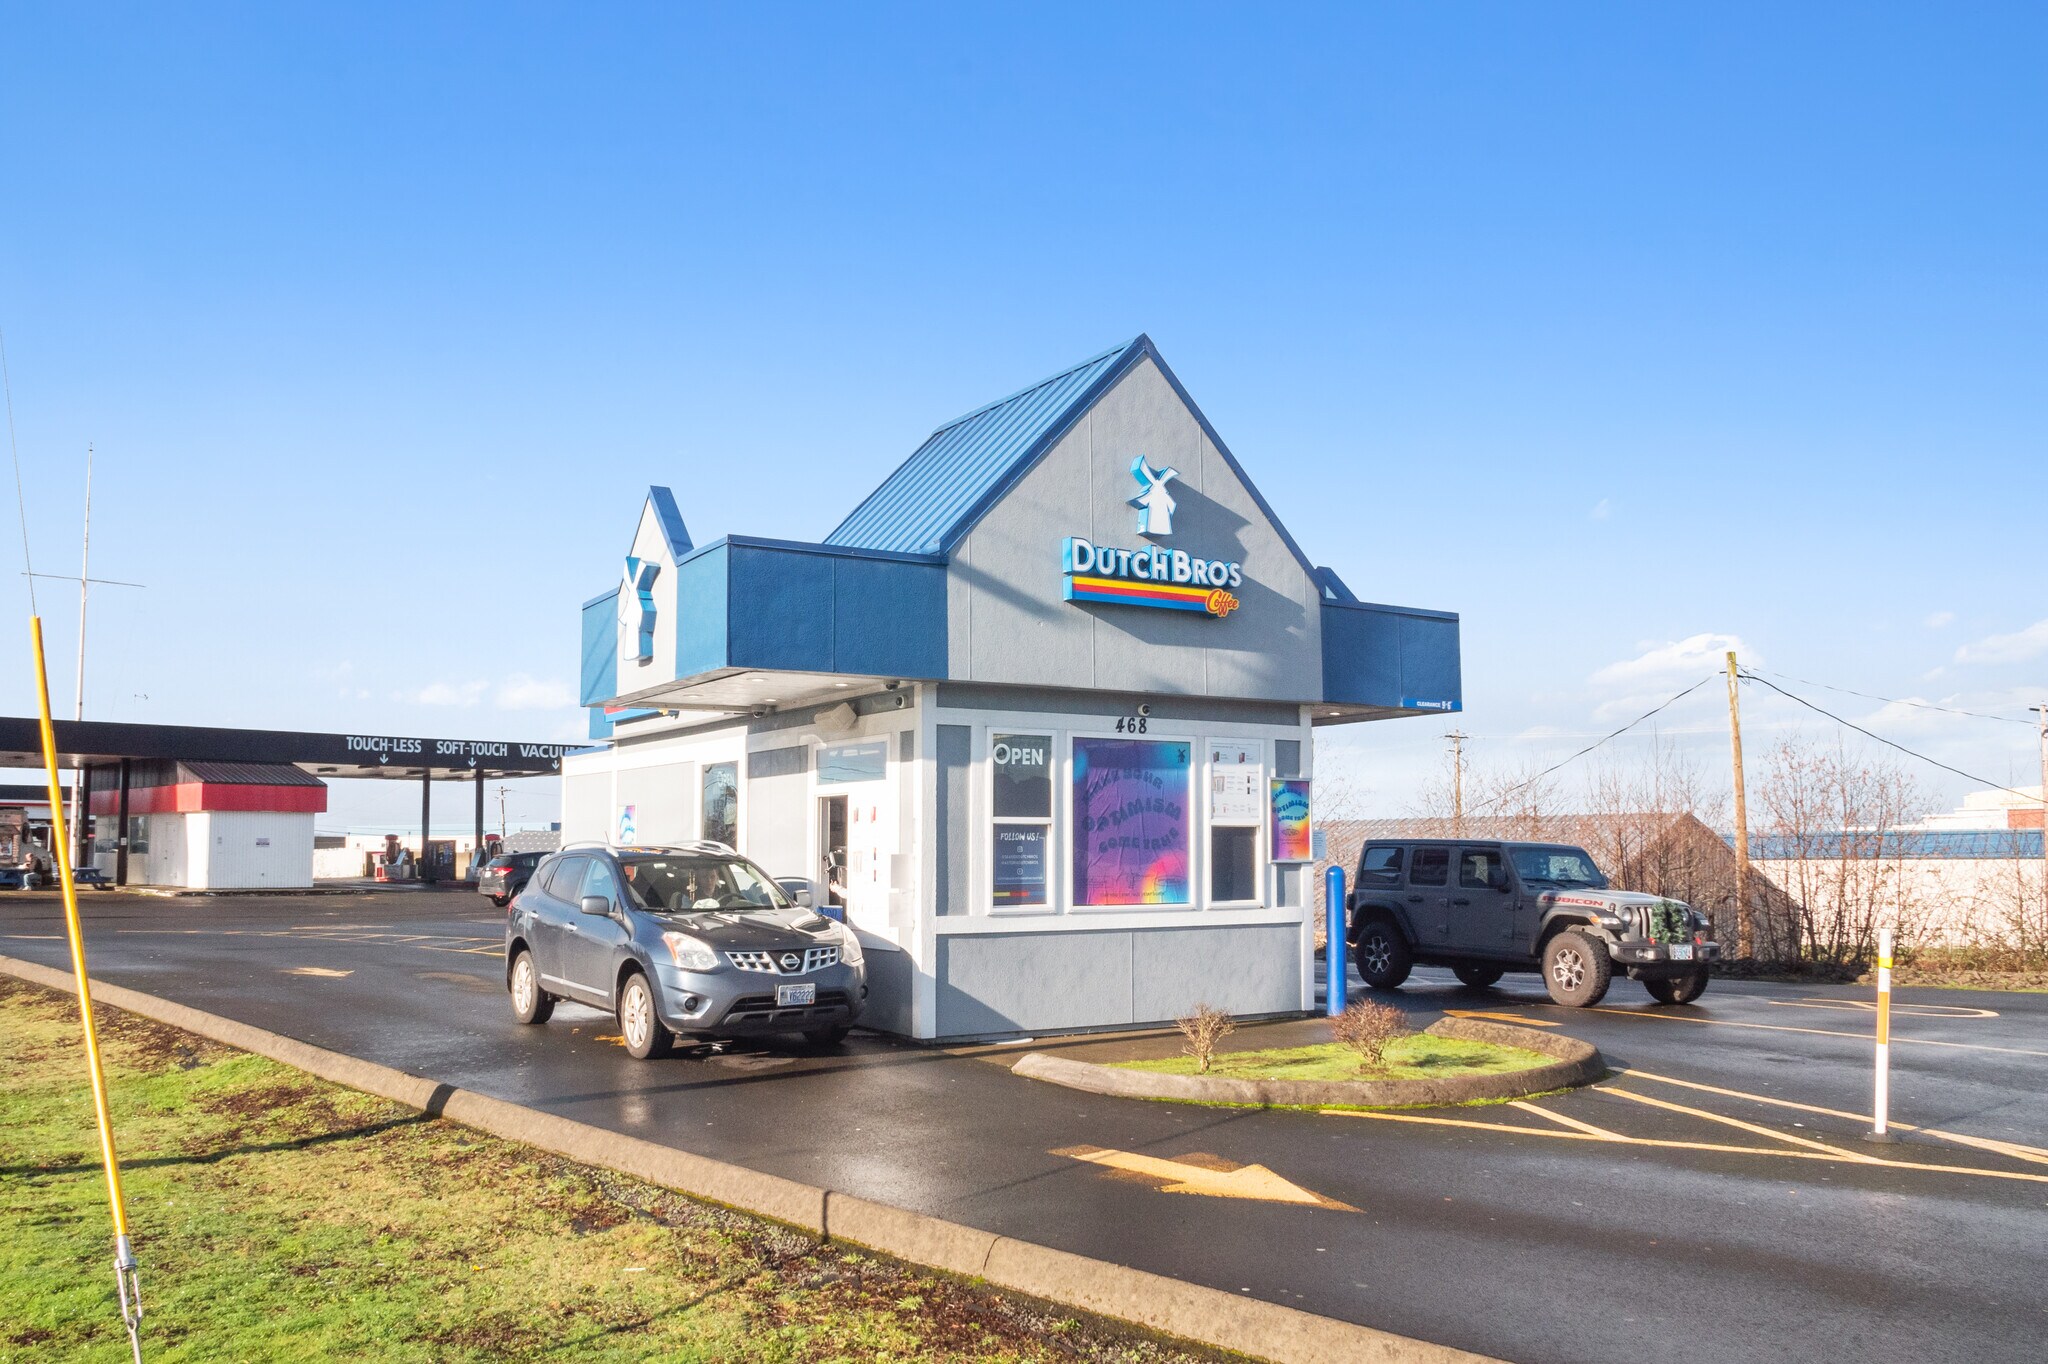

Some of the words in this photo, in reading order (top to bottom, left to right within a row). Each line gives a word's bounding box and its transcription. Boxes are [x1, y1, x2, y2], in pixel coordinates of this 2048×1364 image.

[1206, 589, 1239, 617] Coffee
[1115, 715, 1147, 734] 468
[346, 736, 422, 753] TOUCH-LESS
[436, 740, 508, 757] SOFT-TOUCH
[993, 743, 1043, 765] OPEN
[1000, 832, 1026, 842] FOLLOW
[1026, 832, 1040, 842] US!
[1542, 895, 1604, 906] RUBICON
